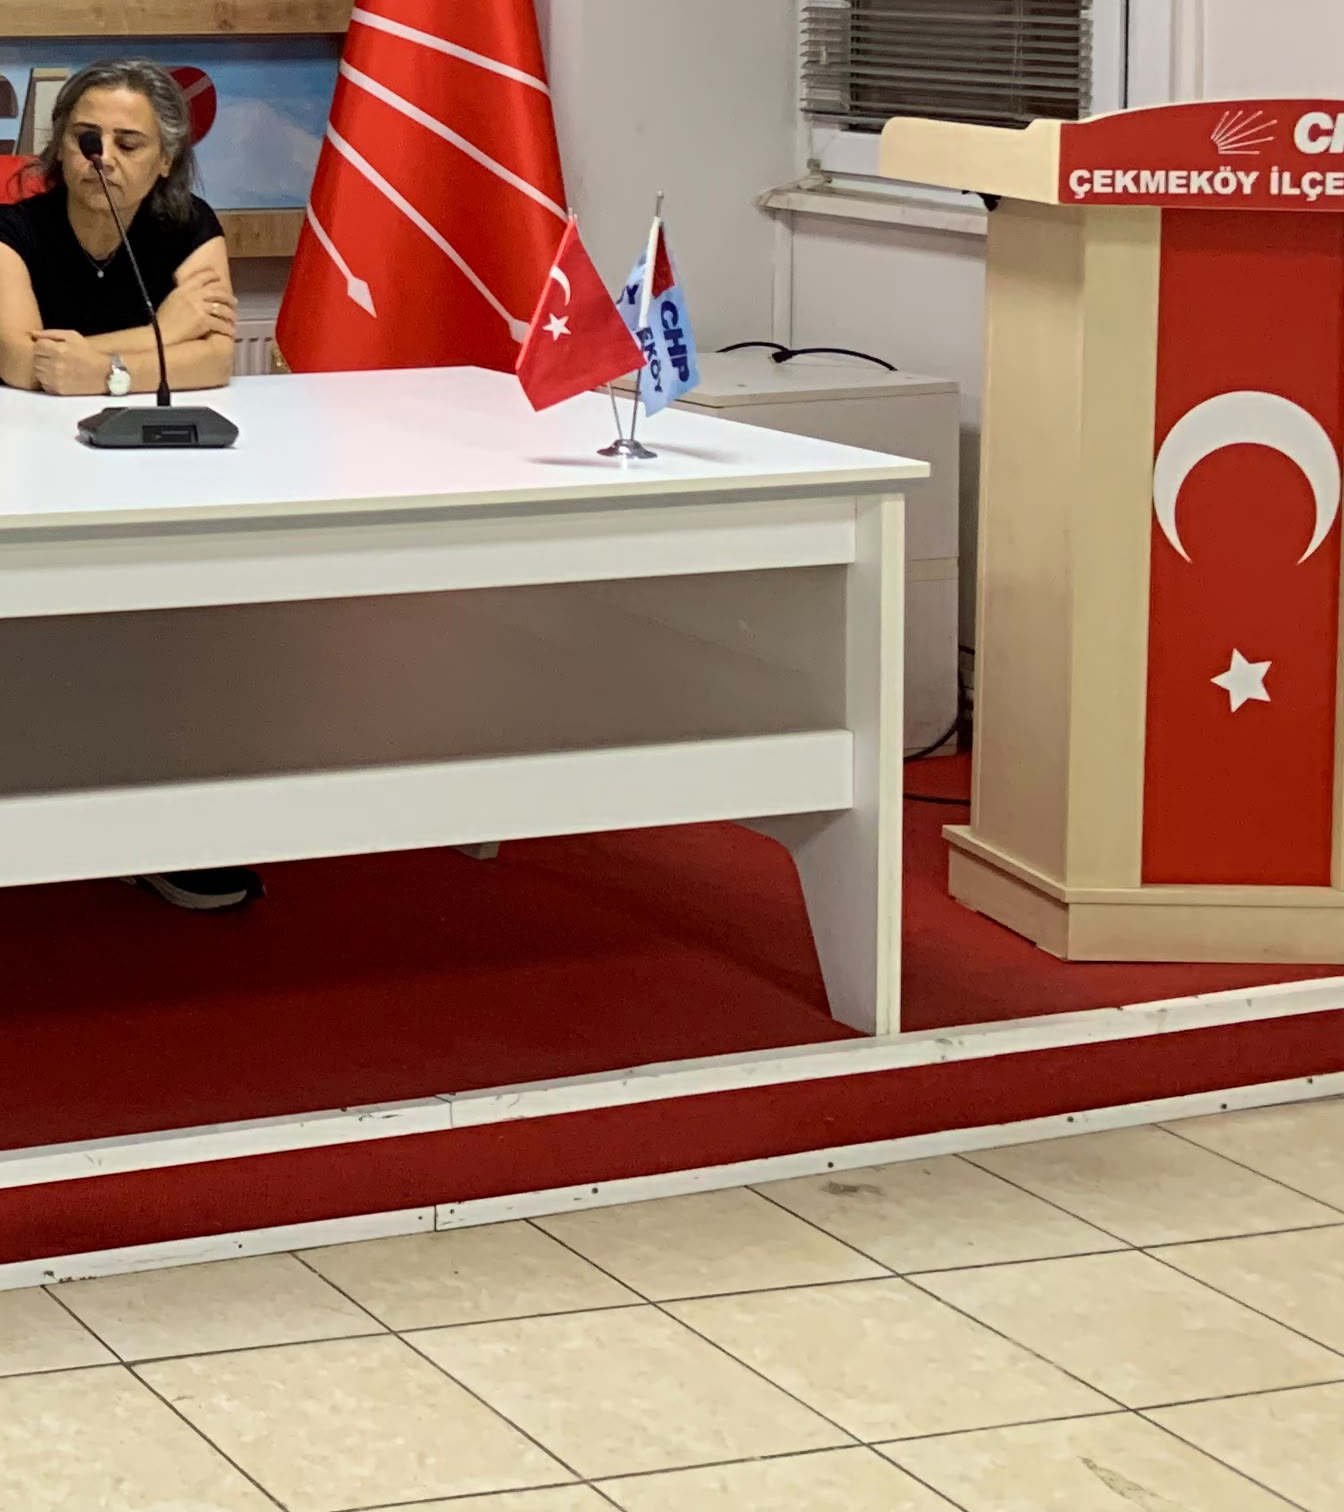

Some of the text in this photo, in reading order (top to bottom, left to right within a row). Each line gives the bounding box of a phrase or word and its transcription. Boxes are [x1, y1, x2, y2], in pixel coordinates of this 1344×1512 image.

[1068, 165, 1344, 202] ÇEKMEKÖY İLÇE
[660, 300, 690, 383] CHP
